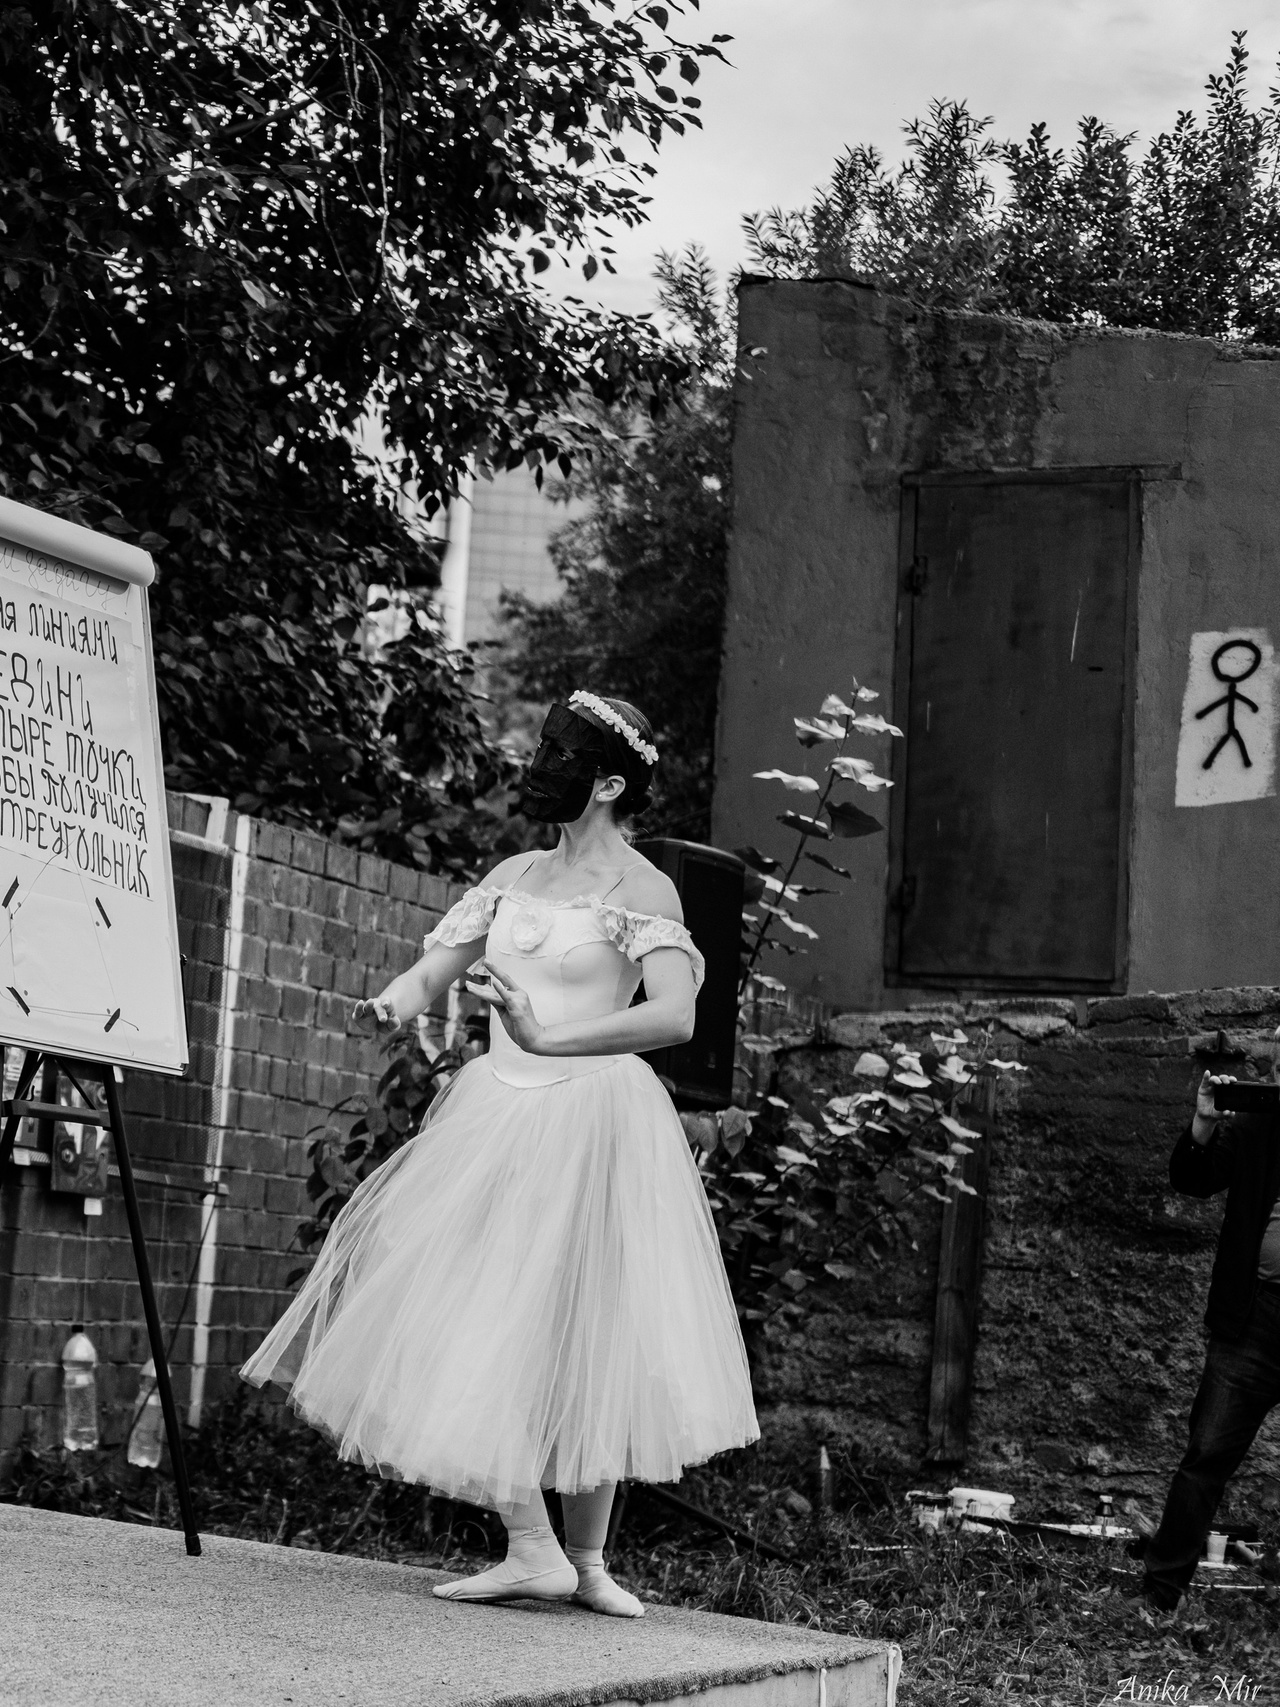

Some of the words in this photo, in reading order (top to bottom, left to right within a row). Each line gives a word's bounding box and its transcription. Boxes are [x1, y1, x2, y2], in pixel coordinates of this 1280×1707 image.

[40, 768, 149, 844] ПОЛУЧИЛСЯ
[66, 731, 147, 811] ТОЧКИ
[0, 797, 151, 898] ТРЕУГОЛЬНИК
